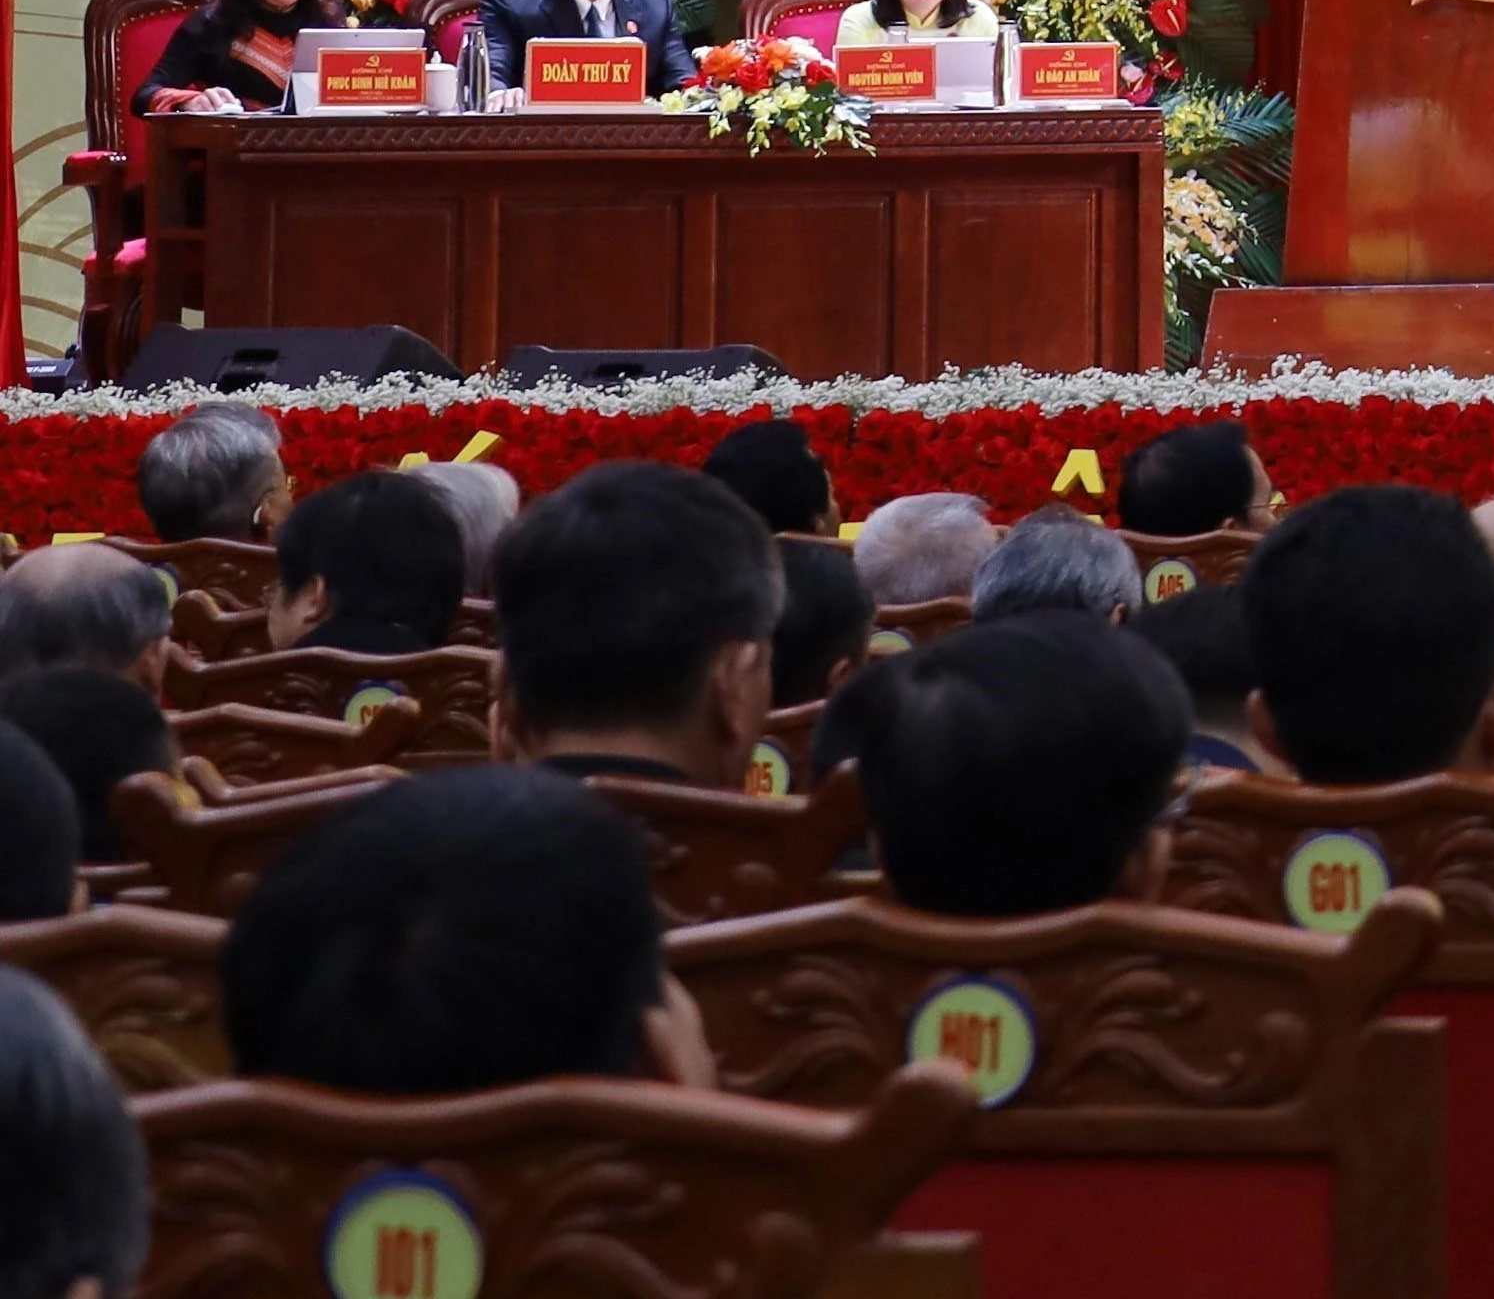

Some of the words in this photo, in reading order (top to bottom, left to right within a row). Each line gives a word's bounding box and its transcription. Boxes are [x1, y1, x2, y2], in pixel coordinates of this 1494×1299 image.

[542, 59, 578, 84] ĐOÀN
[581, 60, 609, 83] THƯ
[612, 58, 632, 83] KÝ
[1157, 573, 1184, 600] A05
[1309, 863, 1362, 914] G01
[941, 1013, 1002, 1075] H01
[379, 1228, 438, 1298] I01
